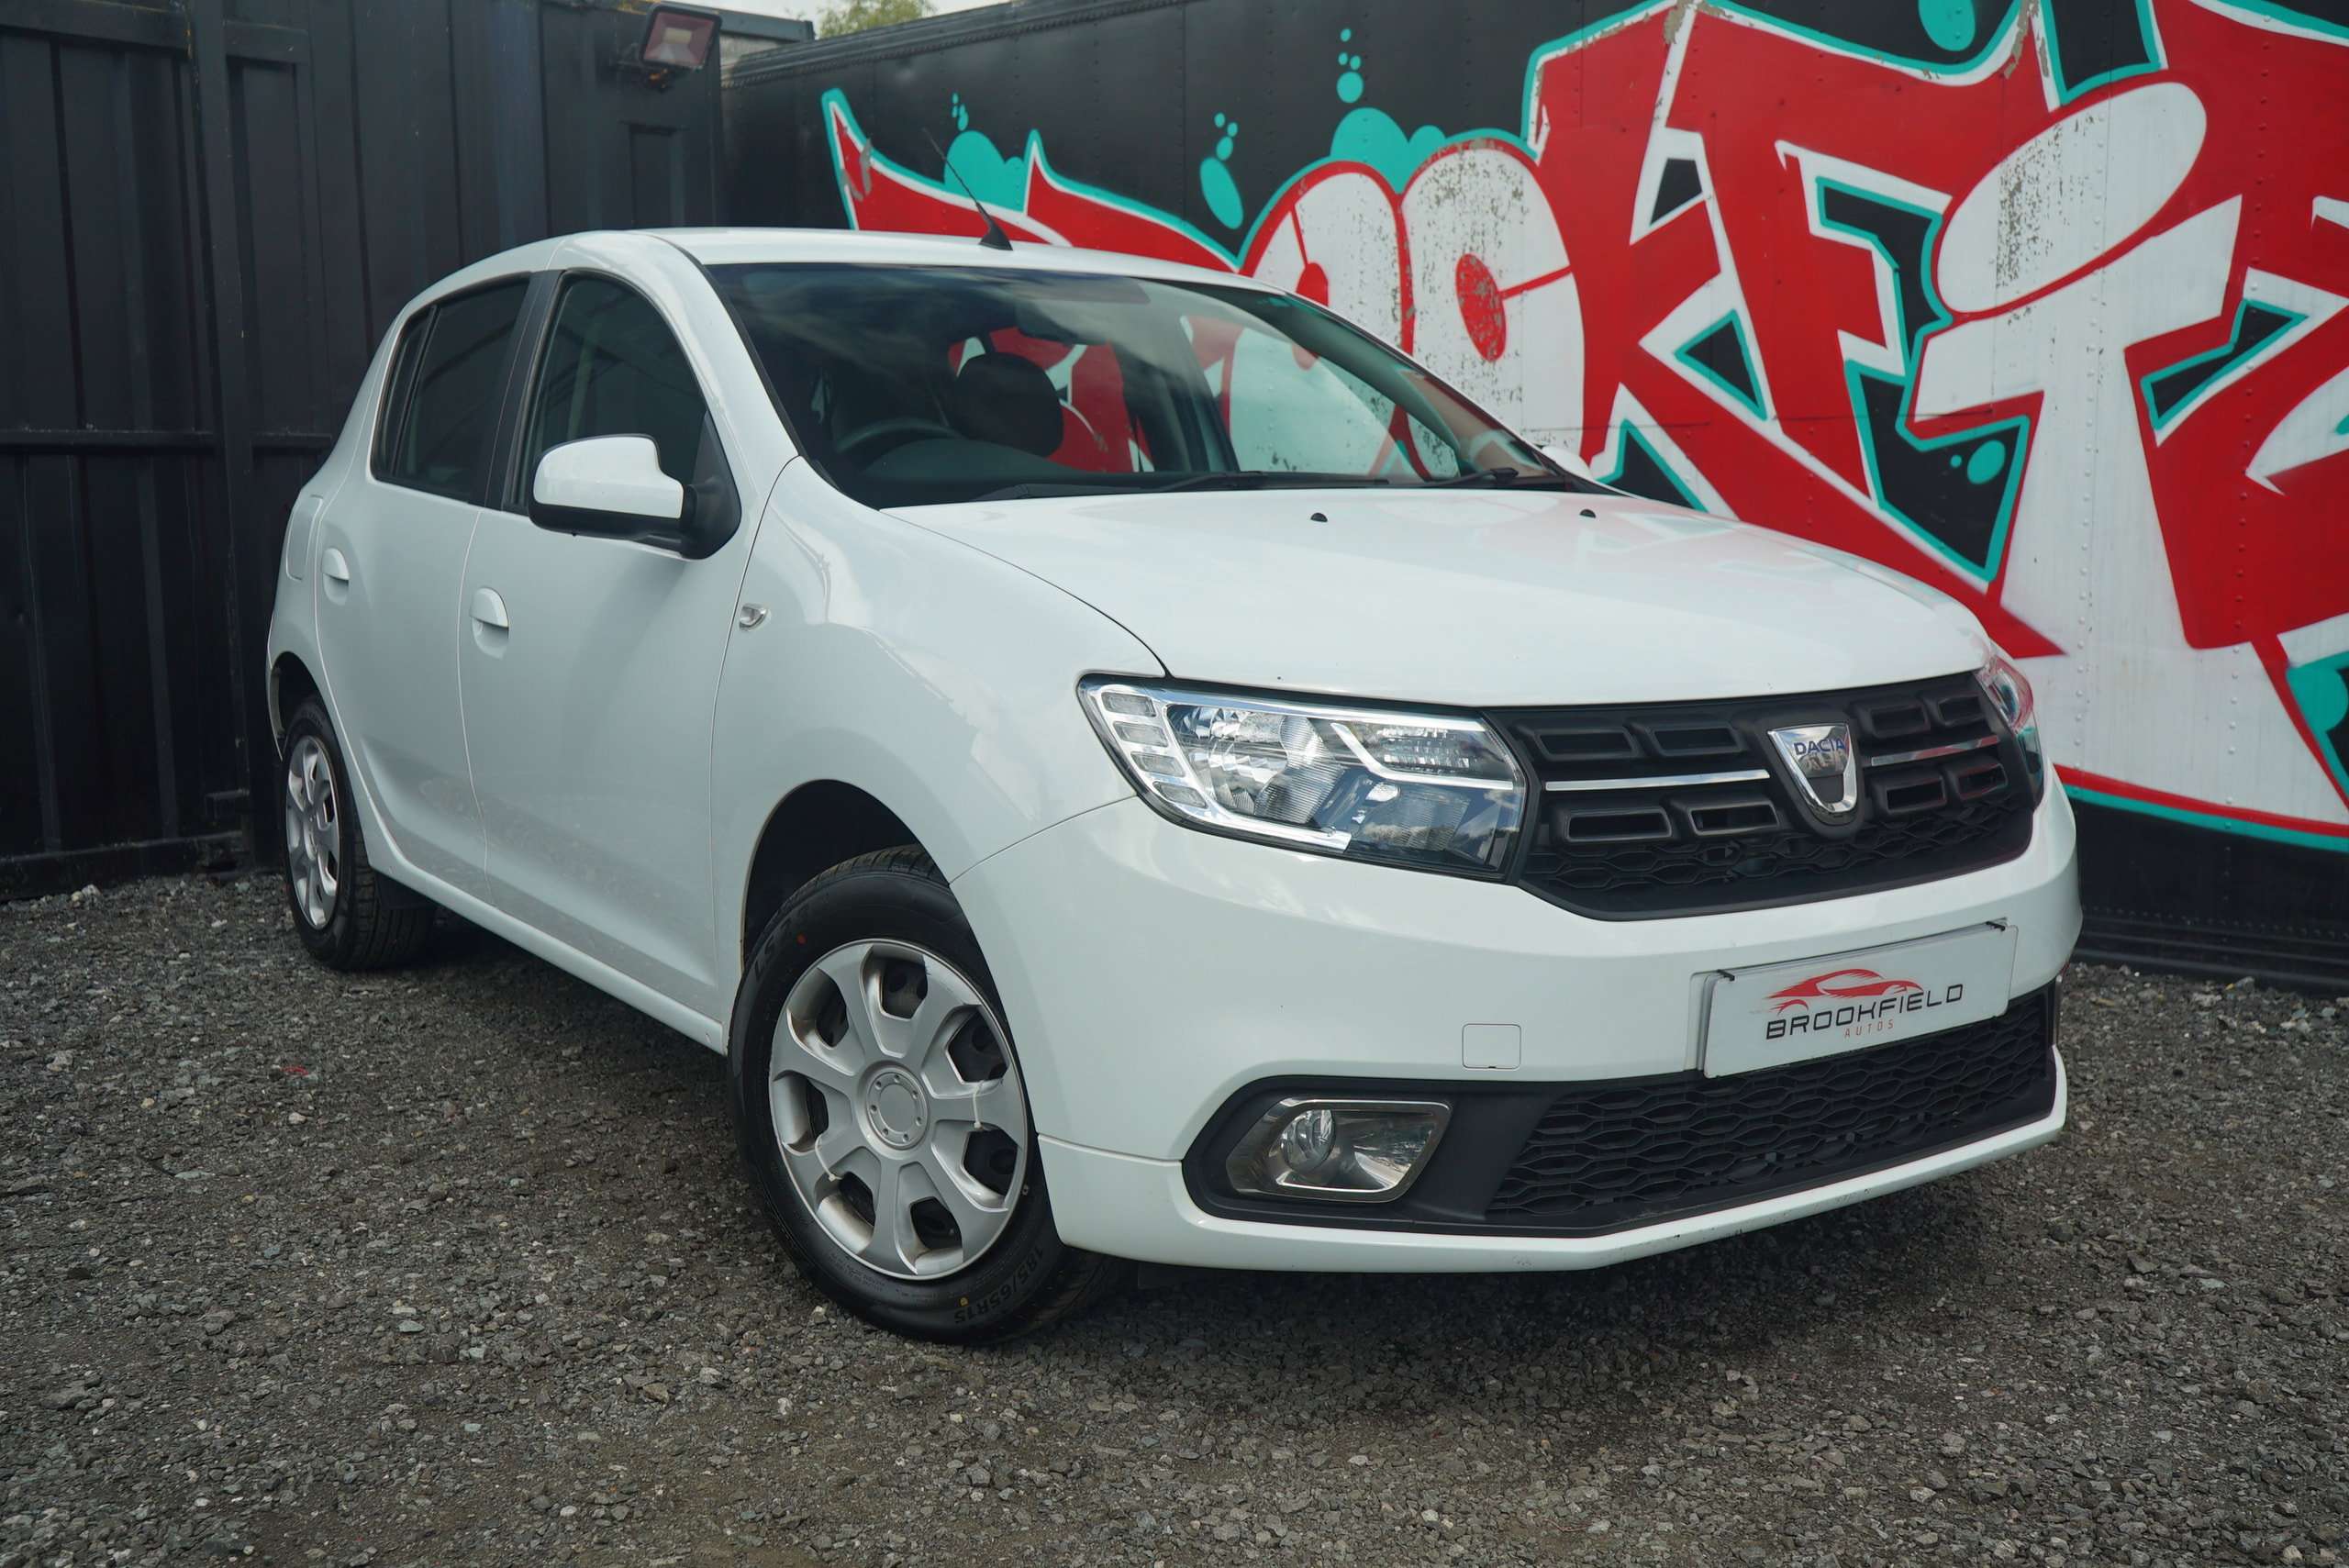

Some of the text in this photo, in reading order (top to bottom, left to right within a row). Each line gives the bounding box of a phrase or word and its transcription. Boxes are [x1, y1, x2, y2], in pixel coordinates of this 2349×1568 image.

[1794, 738, 1846, 755] DACIA
[1766, 984, 1964, 1040] BROOKFIELD
[1843, 1018, 1895, 1039] AUTOS
